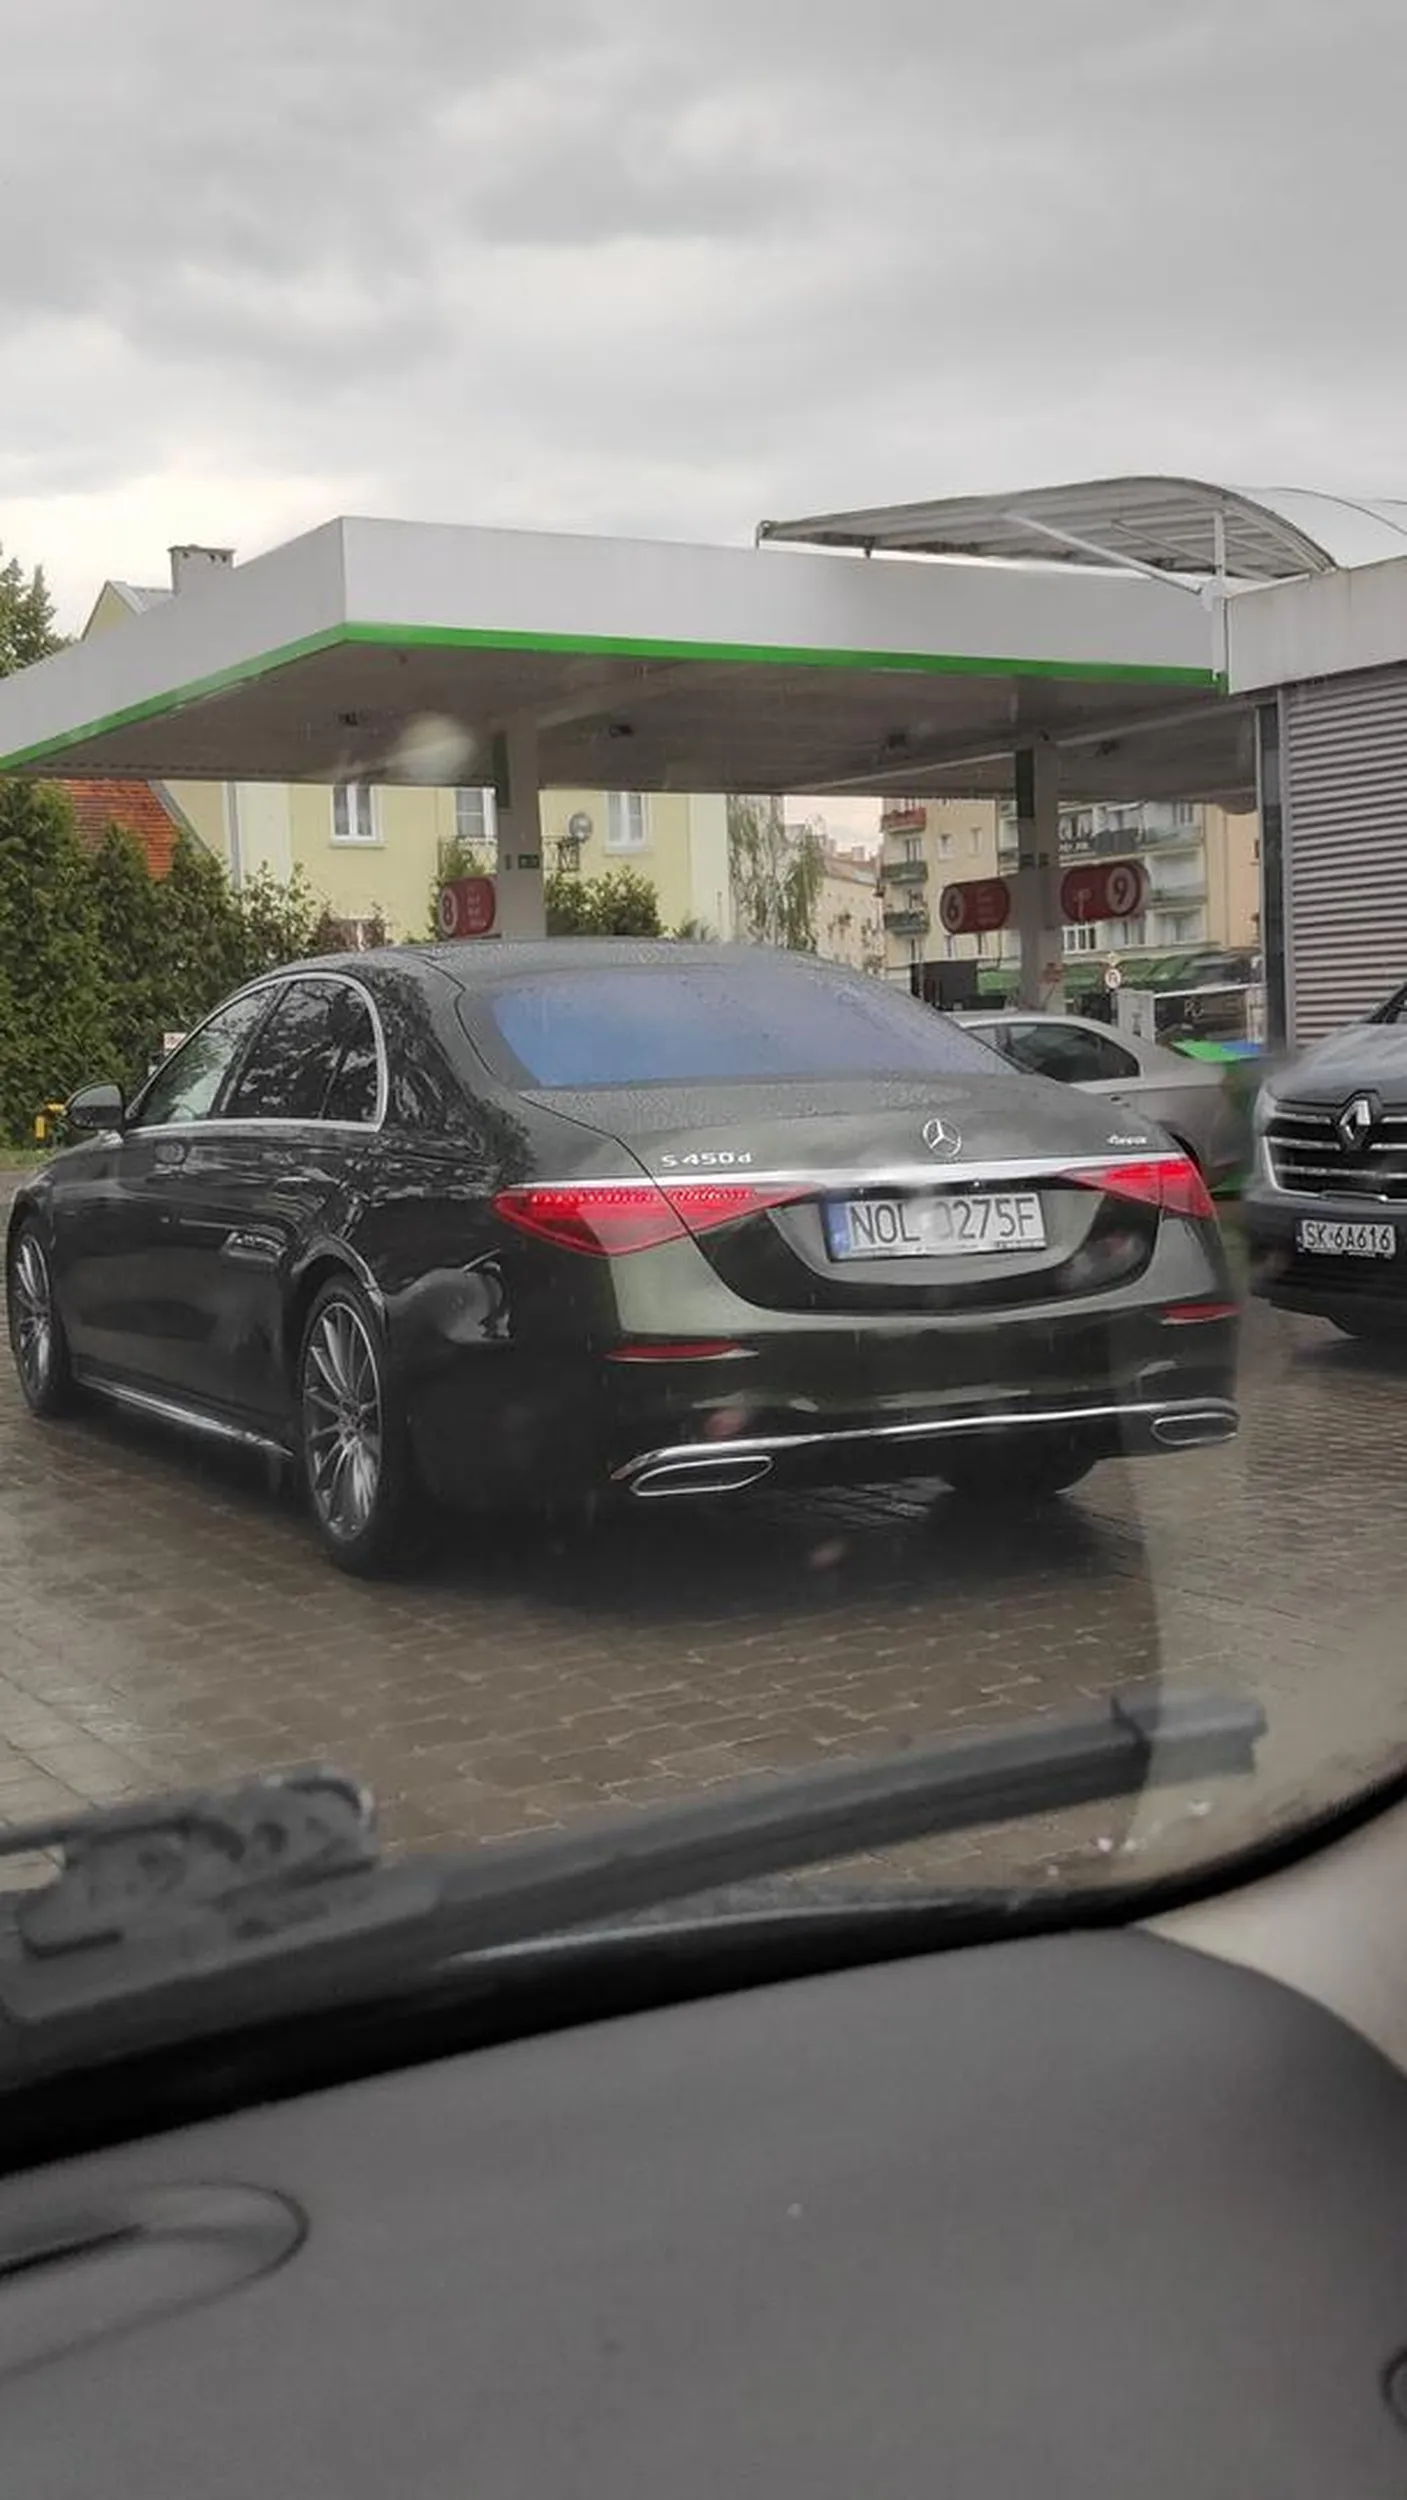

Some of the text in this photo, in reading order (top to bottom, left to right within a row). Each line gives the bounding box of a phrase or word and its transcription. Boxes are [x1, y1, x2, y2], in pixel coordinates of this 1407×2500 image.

[1114, 878, 1128, 905] 9
[442, 894, 454, 926] 8
[945, 893, 959, 920] 6
[661, 1152, 751, 1168] S 450 d
[851, 1202, 921, 1245] NOL
[1305, 1222, 1391, 1251] SK 6A616
